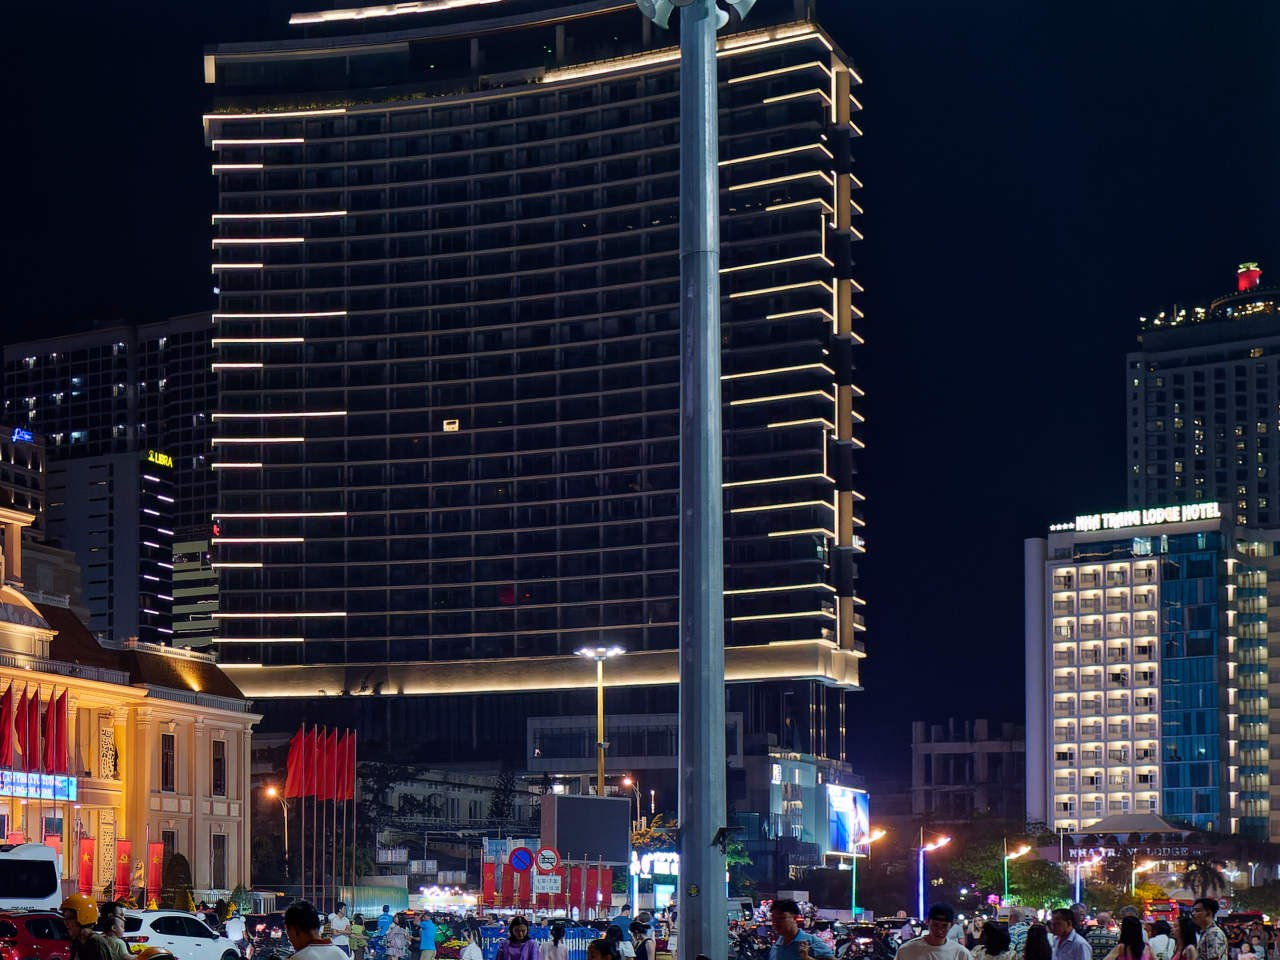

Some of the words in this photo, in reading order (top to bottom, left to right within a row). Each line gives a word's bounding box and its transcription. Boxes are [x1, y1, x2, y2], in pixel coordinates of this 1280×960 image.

[154, 452, 173, 468] LIBRA
[1075, 514, 1101, 532] NHA
[1102, 510, 1140, 528] TRANG
[1142, 506, 1180, 525] LODGE
[1182, 502, 1221, 521] HOTEL
[1146, 847, 1189, 857] LODGE
